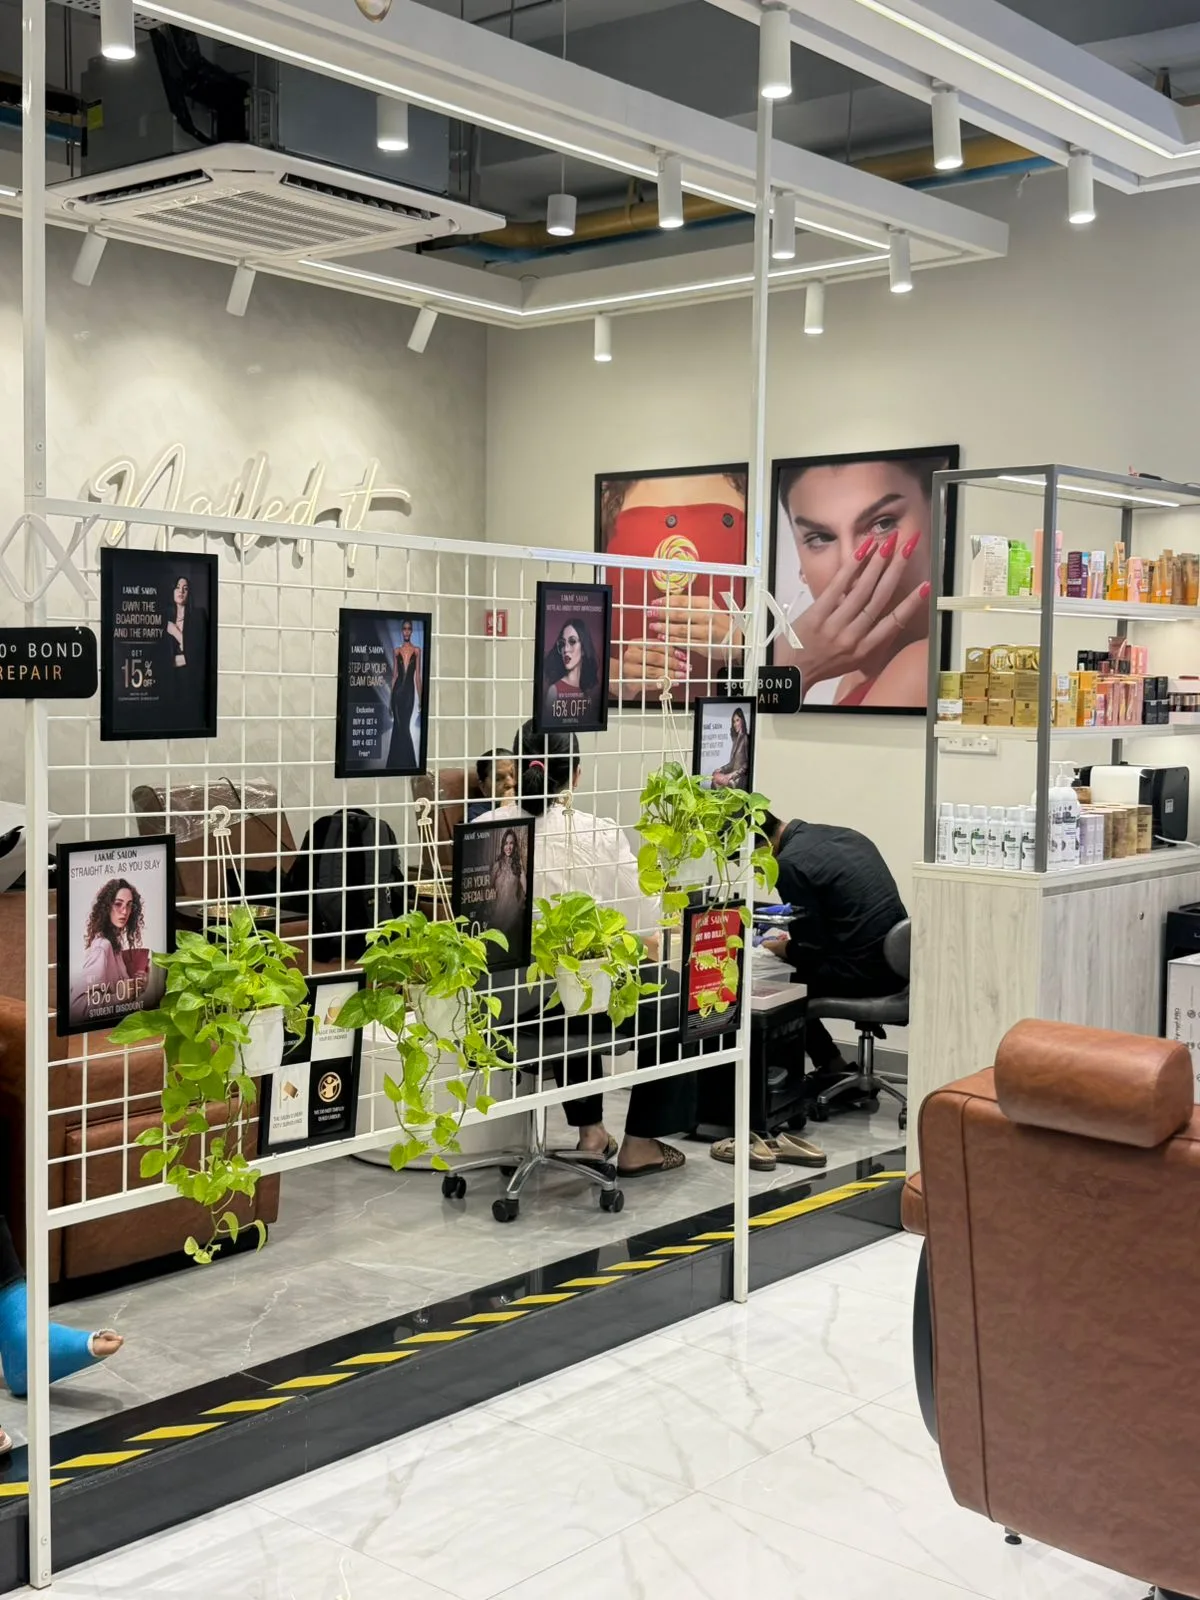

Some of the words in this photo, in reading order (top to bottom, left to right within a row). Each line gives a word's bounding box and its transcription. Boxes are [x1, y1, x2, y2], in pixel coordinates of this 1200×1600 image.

[122, 601, 140, 612] OWN
[142, 602, 156, 612] THE
[116, 613, 162, 625] BOARDROOM
[113, 628, 128, 638] AND
[130, 628, 141, 638] THE
[142, 628, 164, 638] PARTY
[28, 642, 83, 658] BOND
[0, 664, 62, 681] REPAIR
[362, 662, 371, 673] UP
[371, 662, 387, 673] YOUR
[350, 675, 366, 686] GLAM
[757, 678, 793, 690] BOND
[552, 699, 568, 717] 15%
[95, 850, 116, 863] LAKMÉ
[116, 849, 138, 860] SALON
[70, 864, 103, 879] STRAIGHT
[117, 861, 127, 873] AS
[128, 860, 142, 872] YOU
[143, 859, 161, 871] SLAY
[473, 874, 490, 888] YOUR
[460, 889, 485, 905] SPECIAL
[485, 888, 497, 901] DAY
[86, 982, 111, 1006] 15%
[88, 1005, 114, 1018] STUDENT
[115, 1000, 145, 1014] DISCOUNT
